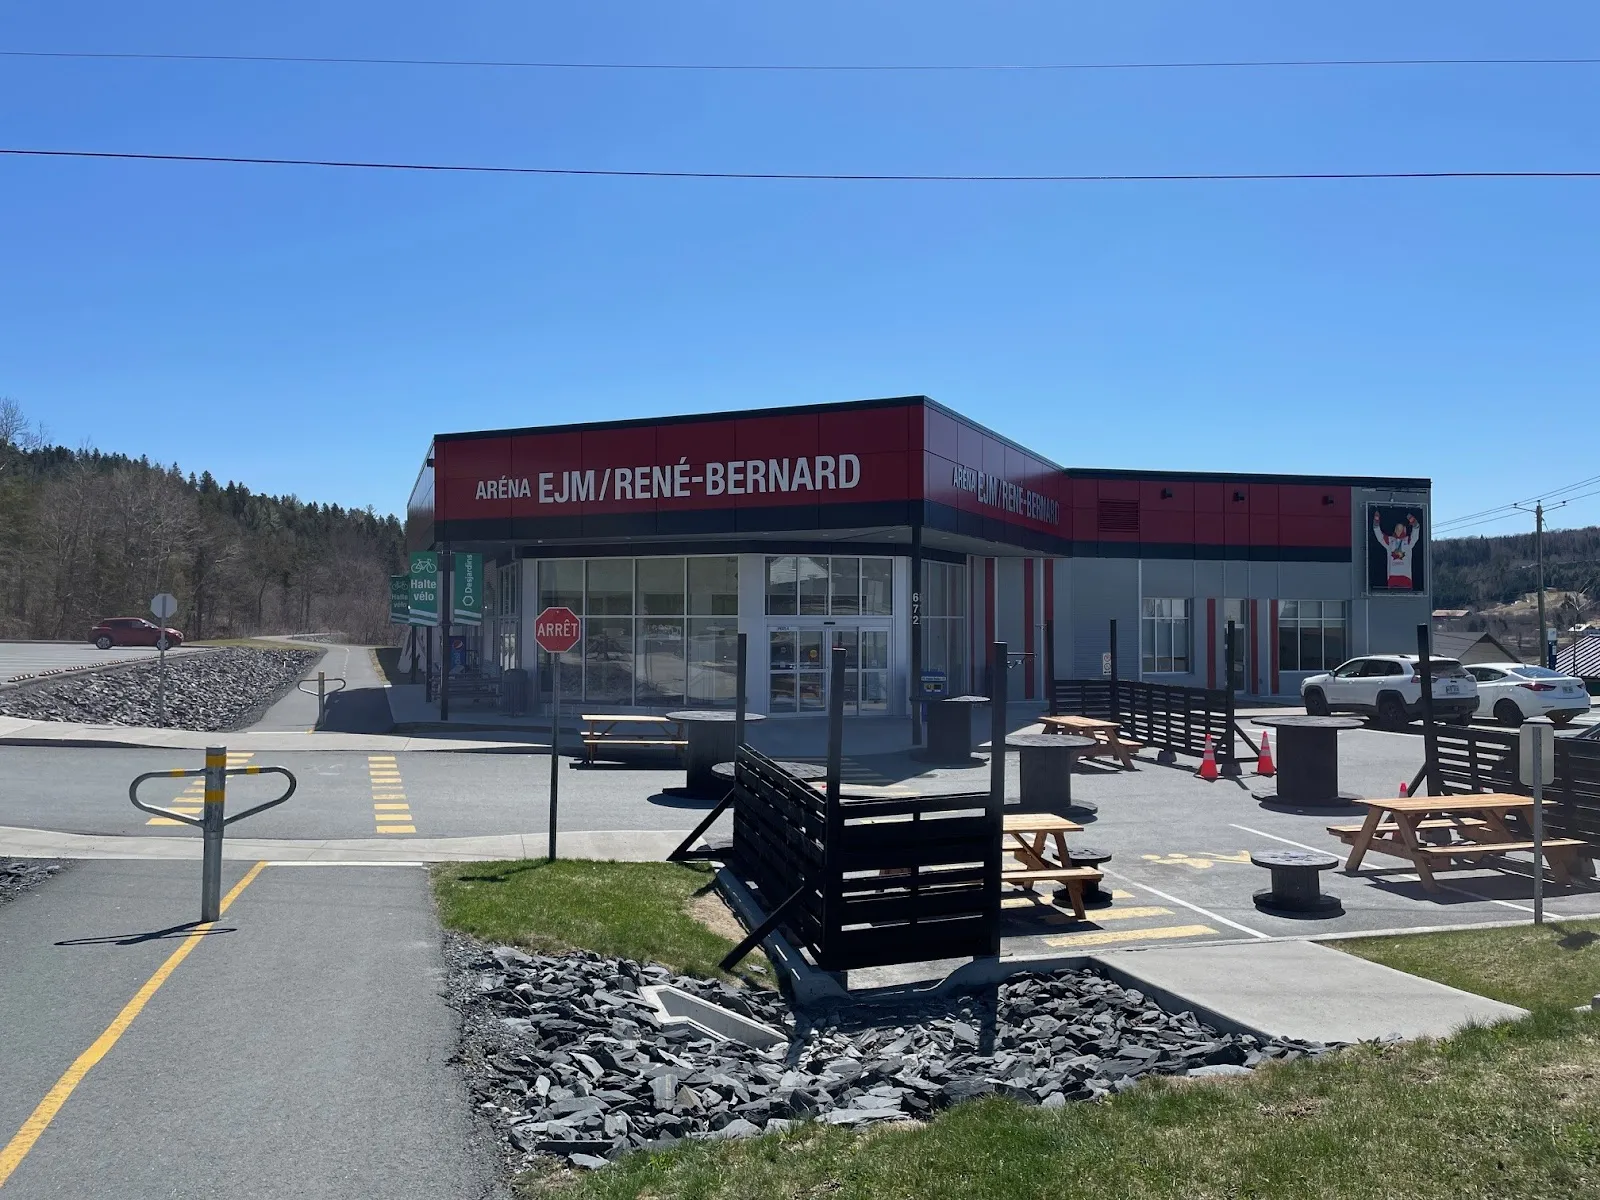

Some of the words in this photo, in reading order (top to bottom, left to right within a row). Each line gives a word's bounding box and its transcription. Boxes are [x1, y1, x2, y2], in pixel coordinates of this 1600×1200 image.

[475, 475, 531, 499] ARÉNA
[464, 554, 474, 594] Desjardins
[410, 579, 437, 589] Halte
[413, 591, 434, 601] vélo
[537, 618, 578, 637] ARRÊT
